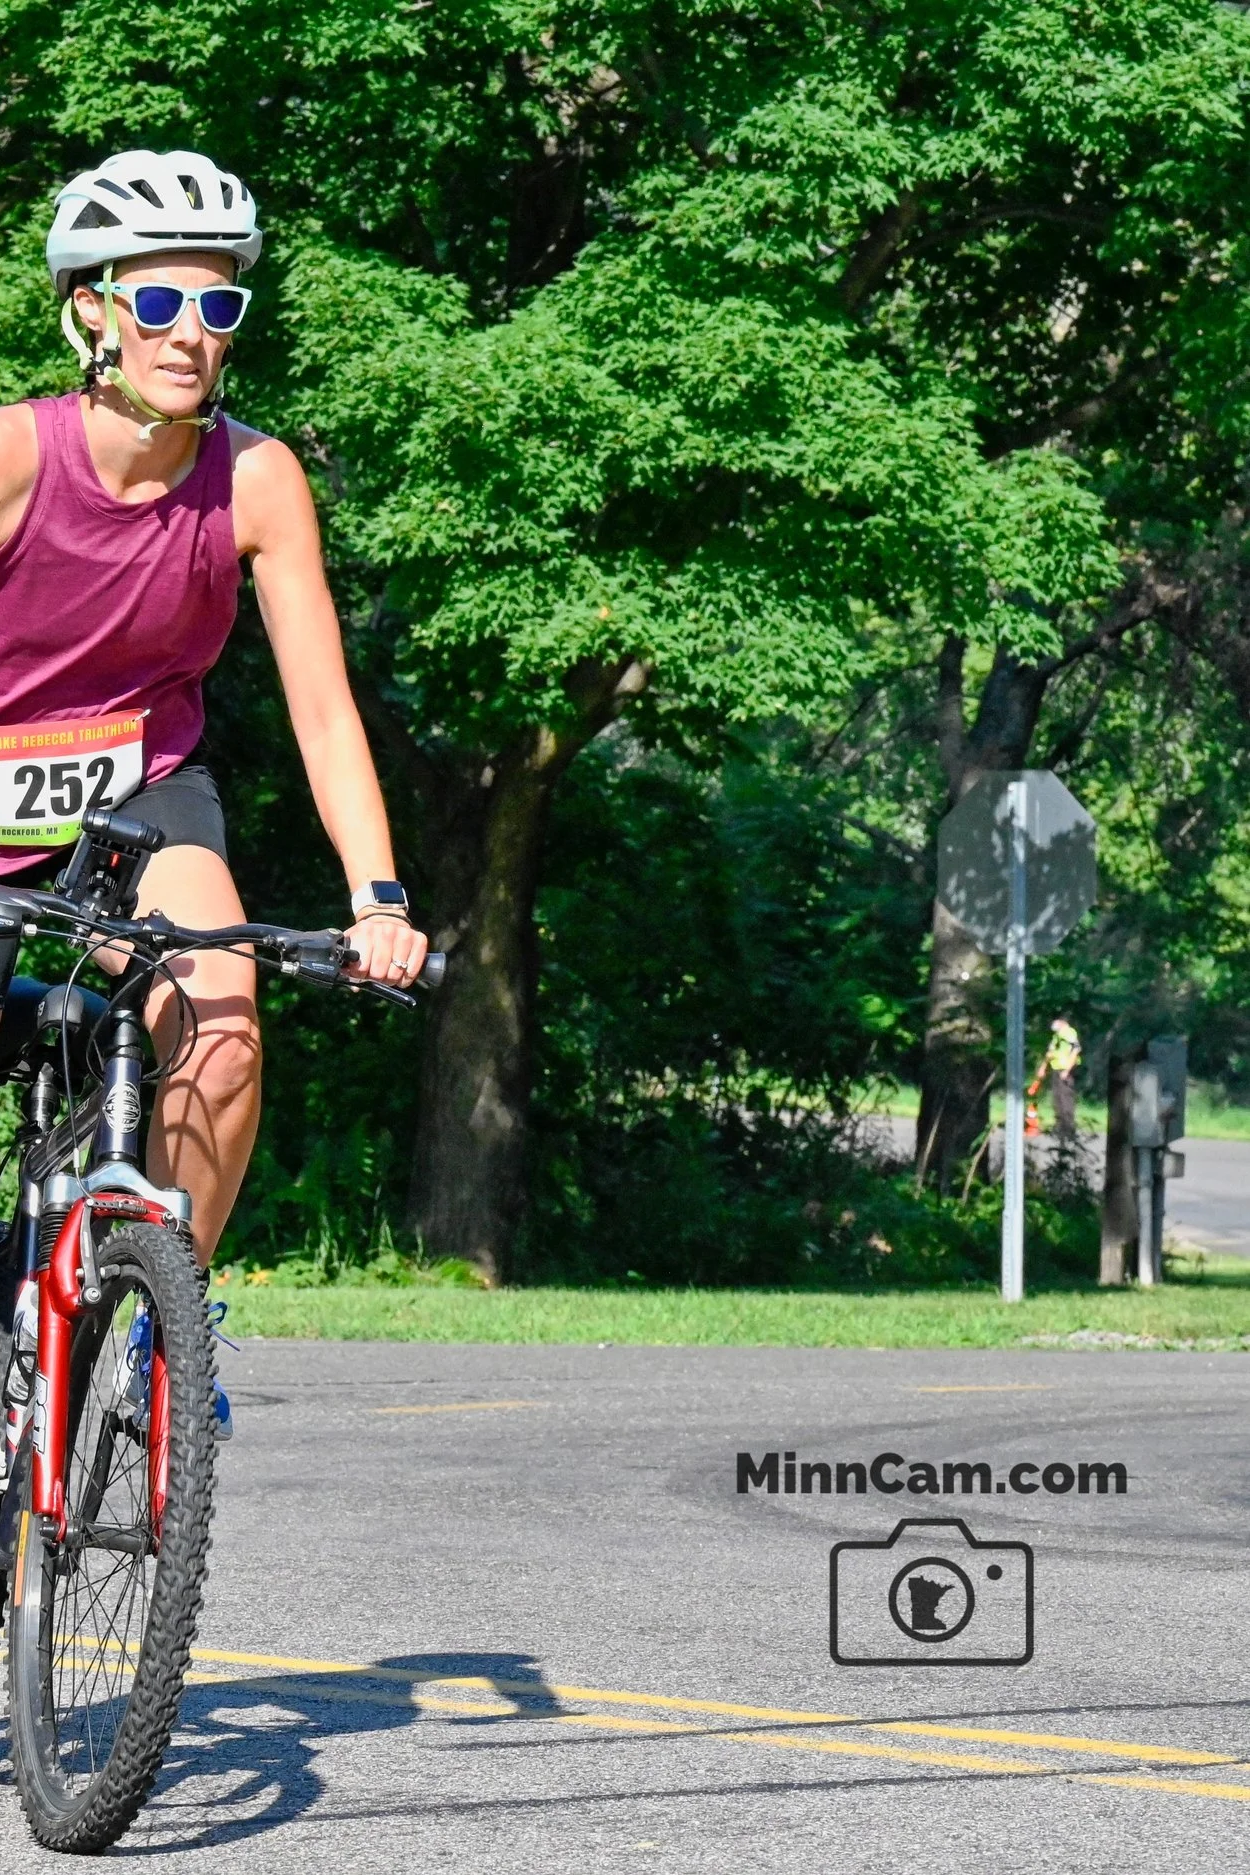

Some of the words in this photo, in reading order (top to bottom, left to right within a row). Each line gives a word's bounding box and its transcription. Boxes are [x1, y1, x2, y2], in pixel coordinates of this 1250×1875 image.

[22, 730, 75, 749] REBECCA
[78, 719, 138, 742] TRIATHLON
[13, 756, 115, 820] 252
